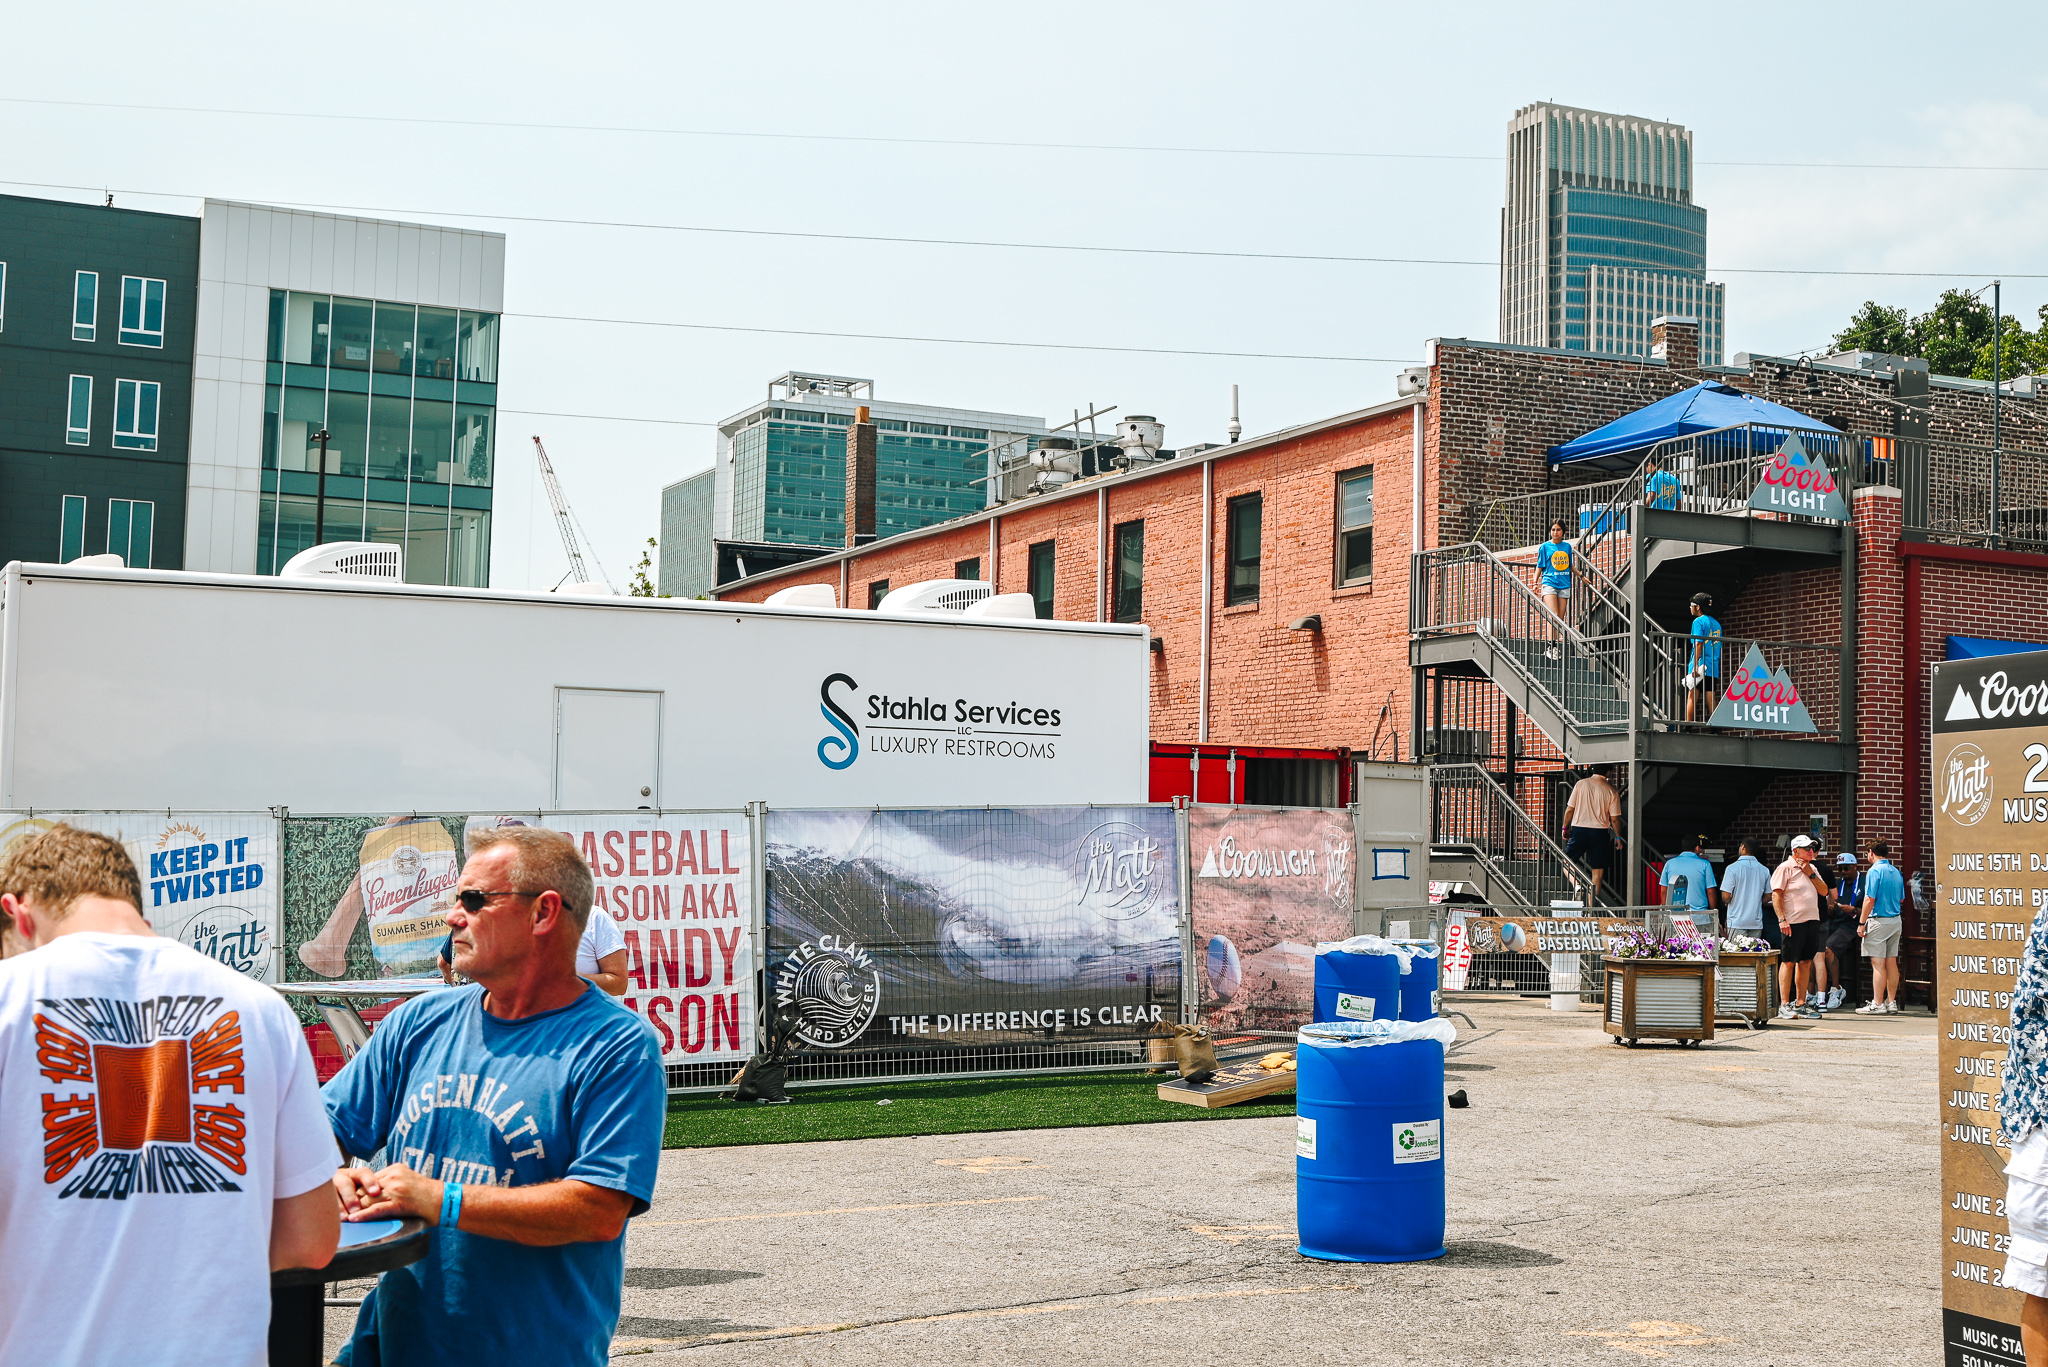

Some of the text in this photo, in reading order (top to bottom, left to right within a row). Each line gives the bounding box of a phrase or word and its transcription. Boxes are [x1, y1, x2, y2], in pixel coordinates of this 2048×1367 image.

[1764, 453, 1837, 494] Coors
[1770, 487, 1826, 511] LIGHT
[1726, 668, 1800, 706] Coors
[867, 694, 1061, 727] Stahla Services
[1733, 703, 1790, 724] LIGHT
[957, 726, 972, 736] LLC
[871, 735, 1055, 759] LUXURY RESTROOMS
[1950, 757, 1964, 774] the
[1941, 755, 1990, 815] Matt
[2003, 798, 2048, 824] MUS
[150, 836, 248, 879] KEEP IT
[1090, 838, 1114, 858] the
[1219, 835, 1317, 878] Coors LIGHT
[1078, 836, 1159, 908] Matt
[1948, 853, 1984, 872] JUNE
[1987, 853, 2023, 872] 15TH
[150, 863, 264, 907] TWISTED
[1949, 887, 1986, 906] JUNE
[1988, 888, 2024, 907] 16TH
[595, 882, 738, 922] ASON AKA
[194, 922, 218, 940] the
[376, 924, 417, 937] SUMMER
[1472, 926, 1494, 948] Matt
[1533, 921, 1600, 935] WELCOME
[1950, 921, 2026, 941] JUNE 17TH
[193, 920, 266, 973] Matt
[1444, 925, 1461, 973] ONLY
[1538, 936, 1605, 951] BASEBALL
[624, 926, 741, 990] ANDY
[776, 934, 873, 1008] WHITE CLAW
[1950, 954, 1988, 974] JUNE
[253, 966, 264, 980] RILL
[1952, 988, 1991, 1009] JUNE
[36, 995, 224, 1044] THEHUNDREDS
[623, 992, 740, 1056] SON
[795, 984, 874, 1041] HARD SELTZER
[889, 1004, 1163, 1034] THE DIFFERENCE IS CLEAR
[1948, 1022, 1988, 1042] JUNE
[1954, 1056, 1996, 1078] JUNE
[32, 1013, 99, 1184] SINCE 1980
[190, 1010, 247, 1176] SINCE 1980
[1948, 1090, 1990, 1111] JUNE
[396, 1073, 545, 1162] ROSENBLATT
[1414, 1140, 1428, 1148] Jones
[1428, 1137, 1438, 1146] Barrel
[1950, 1124, 1992, 1146] JUNE
[58, 1145, 243, 1200] THEHUNREDS
[1951, 1192, 2008, 1218] JUNE 2
[1951, 1226, 2012, 1254] JUNE 25
[1951, 1260, 2010, 1289] JUNE 2
[1962, 1326, 2026, 1357] MUSIC STA
